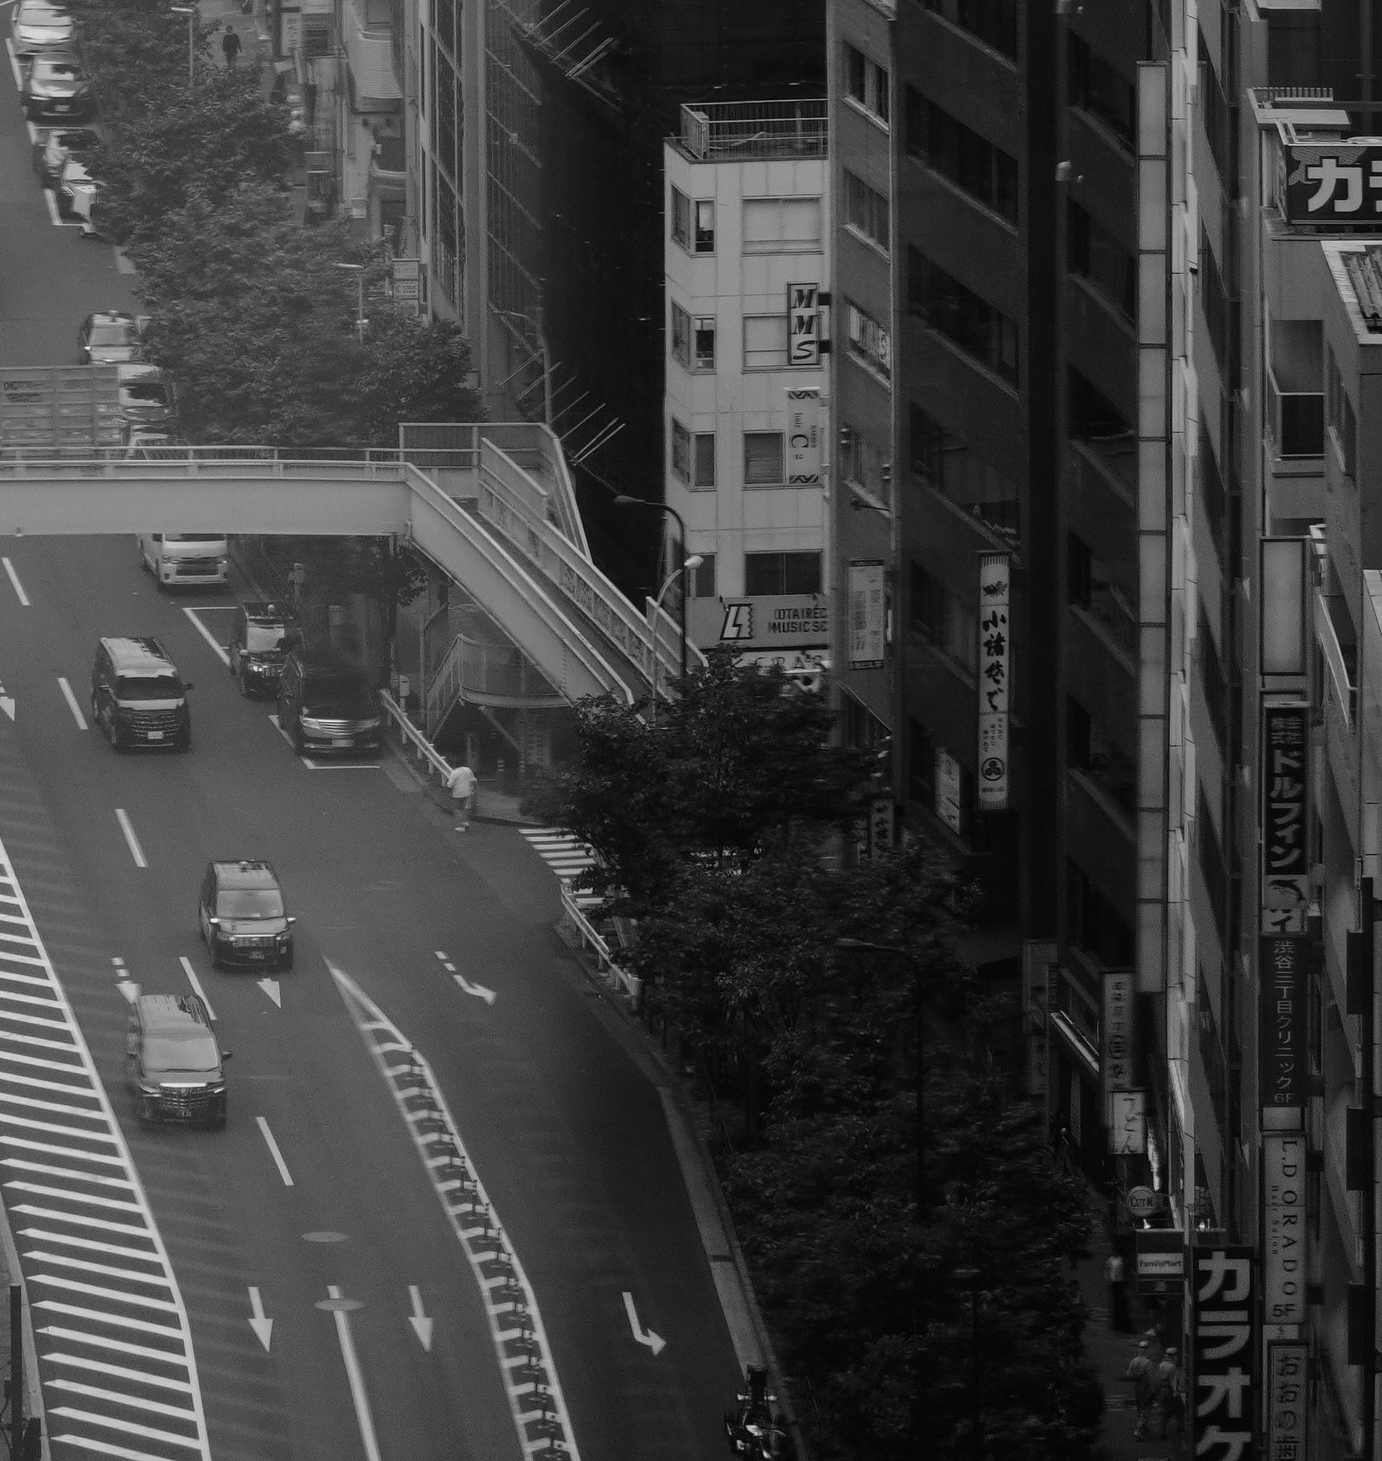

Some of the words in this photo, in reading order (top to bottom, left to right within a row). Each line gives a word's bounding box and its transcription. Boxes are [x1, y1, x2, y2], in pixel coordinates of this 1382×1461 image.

[1307, 158, 1382, 213] カ
[790, 287, 818, 361] MMS
[1269, 749, 1305, 868] ドルフィン
[1273, 939, 1295, 1090] 渋谷三丁目クリニック
[1273, 1092, 1296, 1104] 6F
[1139, 1258, 1182, 1268] FamilyMart
[1196, 1249, 1252, 1461] カラオケ
